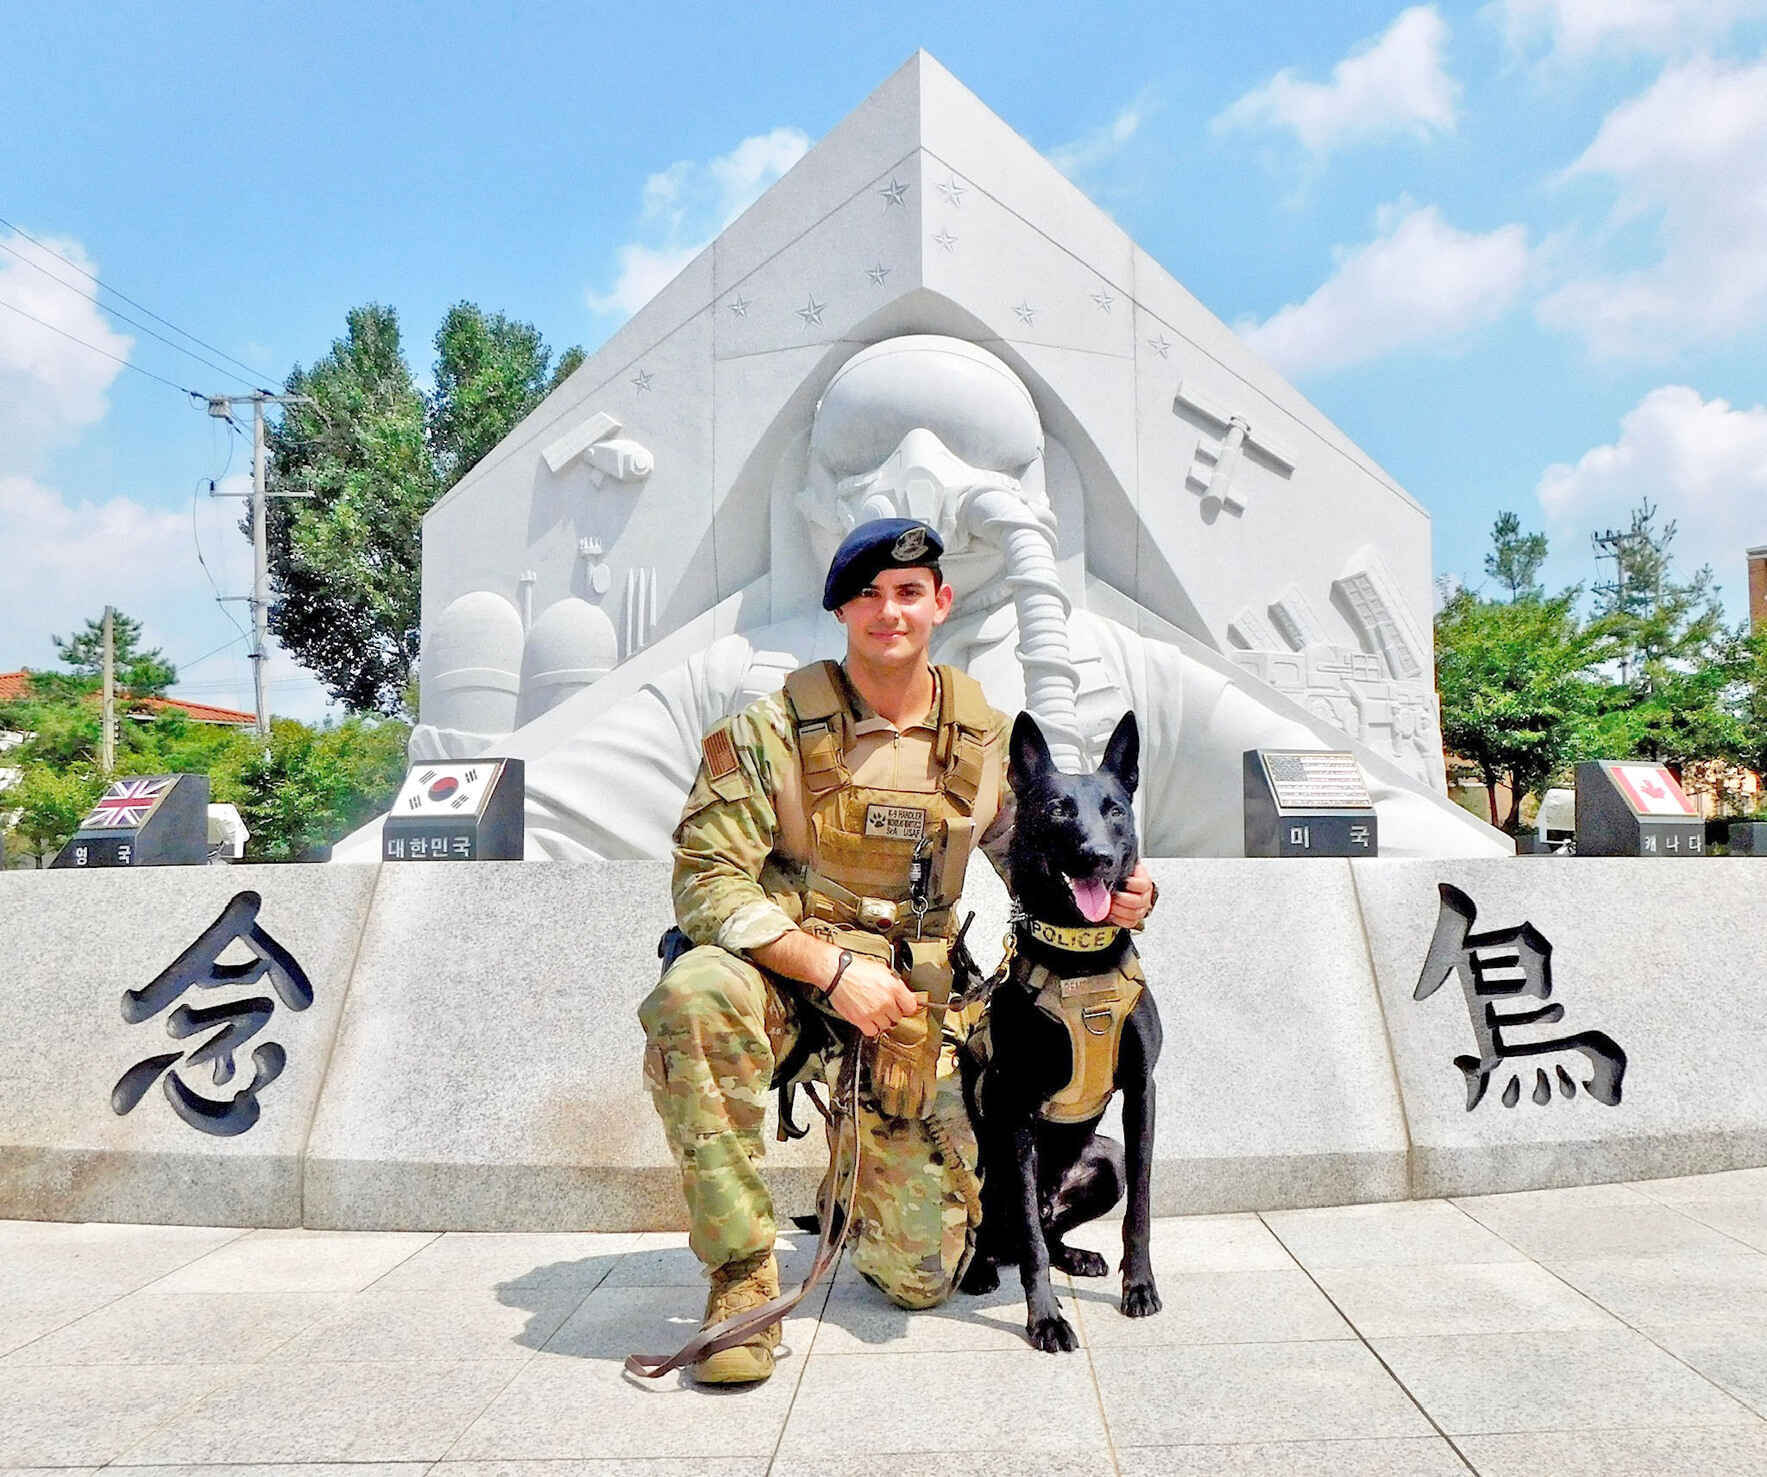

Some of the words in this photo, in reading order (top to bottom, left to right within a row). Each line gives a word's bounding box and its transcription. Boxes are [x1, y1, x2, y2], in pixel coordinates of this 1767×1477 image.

[388, 836, 471, 859] 대한민국
[903, 828, 921, 838] USAF
[1031, 919, 1105, 948] POLICE
[1412, 882, 1628, 1113] 鳥
[111, 889, 314, 1138] 念
